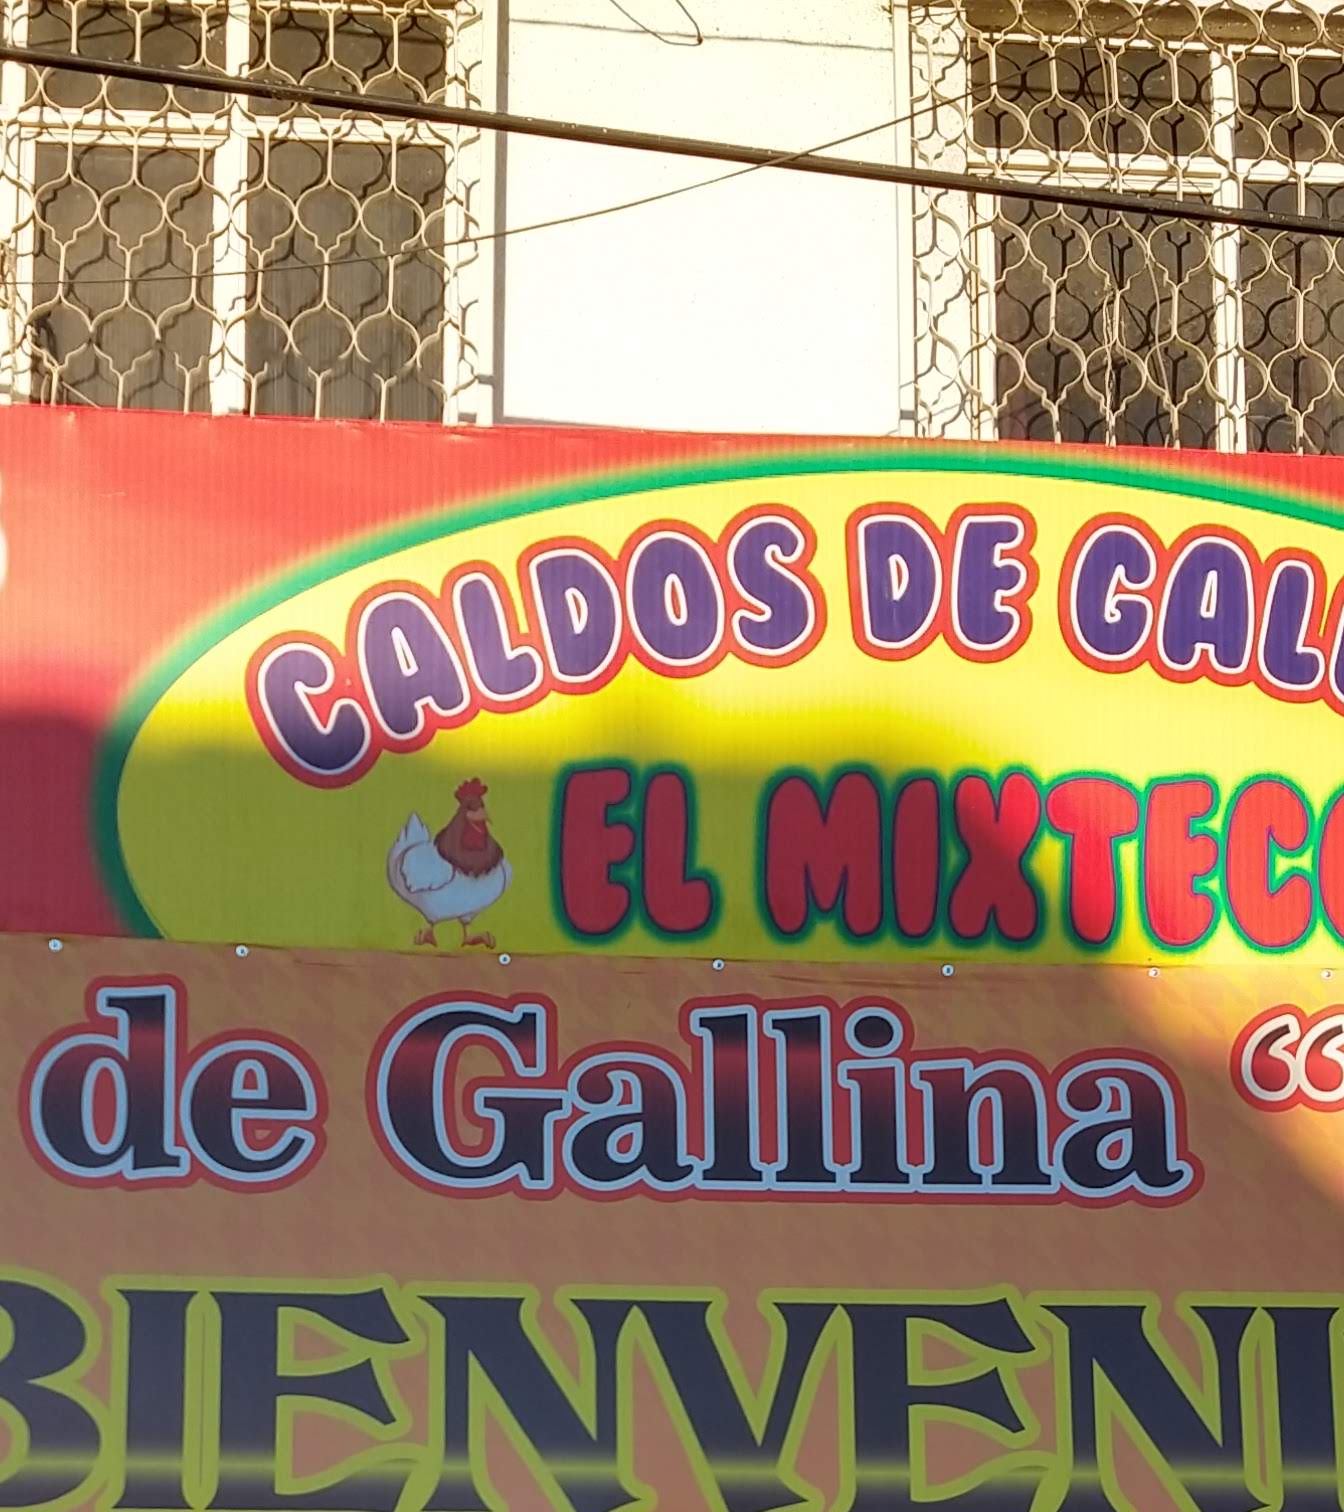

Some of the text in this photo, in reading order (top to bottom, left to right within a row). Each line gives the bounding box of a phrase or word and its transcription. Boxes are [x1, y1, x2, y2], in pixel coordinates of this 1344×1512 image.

[254, 512, 818, 776] CALDOS
[852, 510, 1027, 654] DE
[559, 764, 714, 936] EL
[28, 985, 320, 1183] de
[374, 999, 1196, 1199] Gallina
